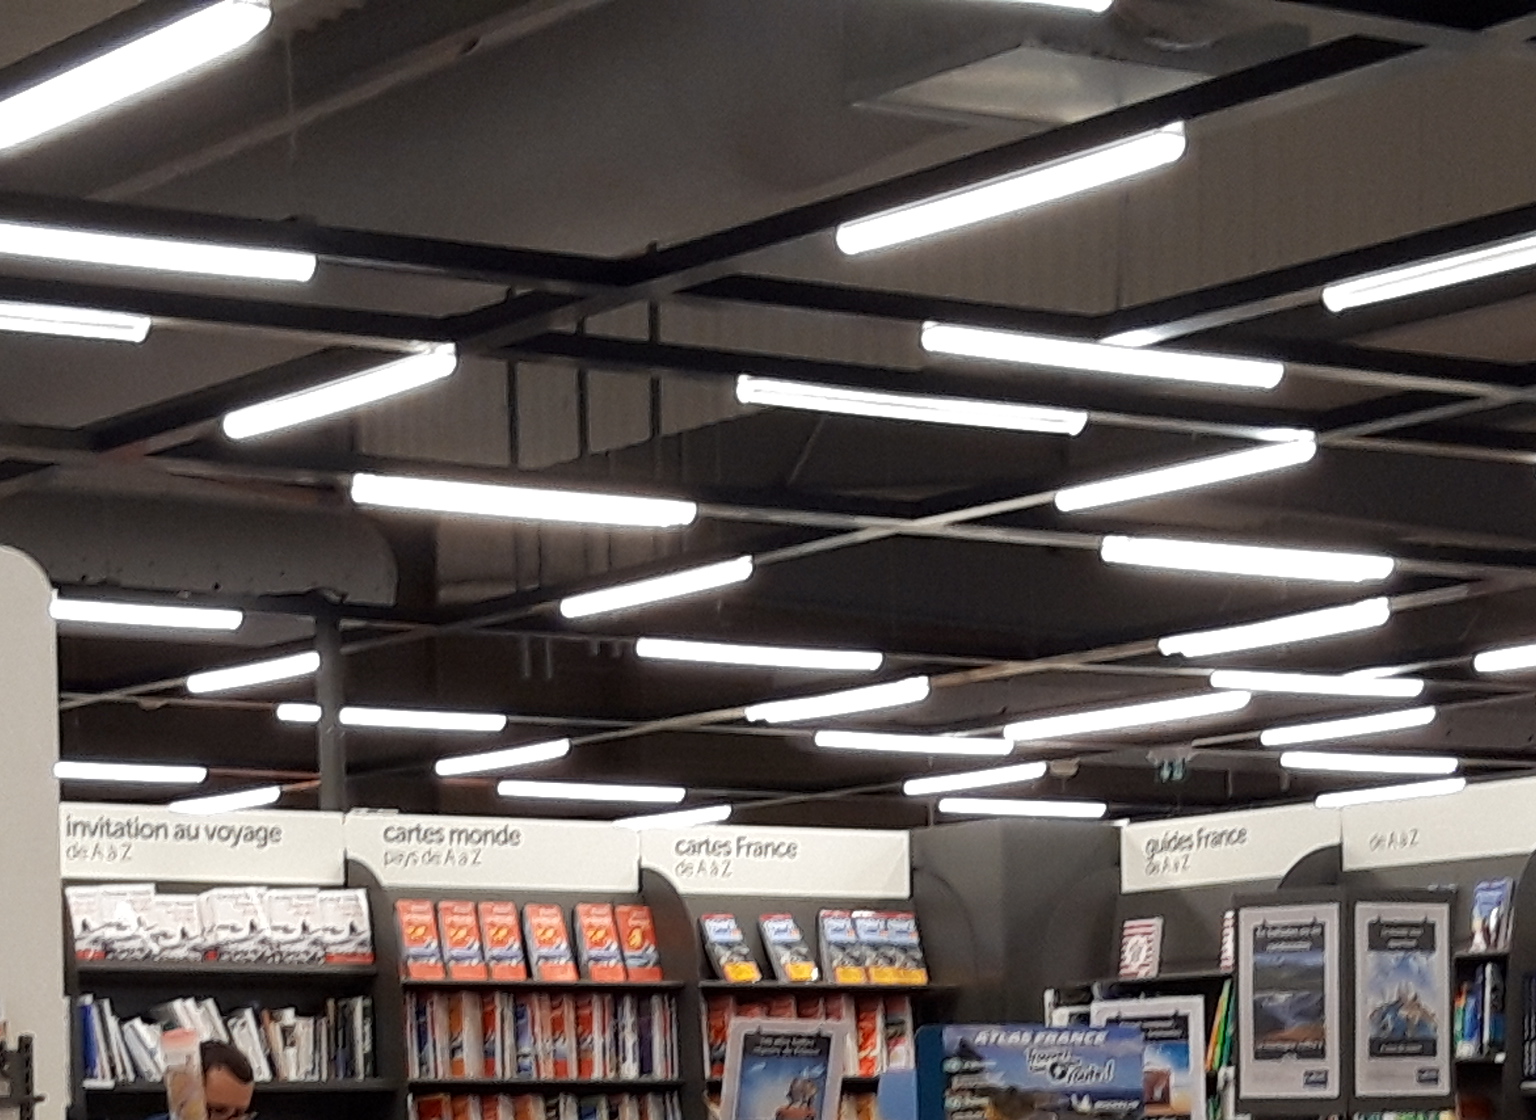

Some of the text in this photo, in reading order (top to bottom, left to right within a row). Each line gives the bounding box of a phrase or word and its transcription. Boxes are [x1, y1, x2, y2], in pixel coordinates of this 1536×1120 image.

[65, 815, 283, 854] invitation au voyage
[383, 824, 521, 846] cartes monde
[675, 836, 798, 858] cartes France
